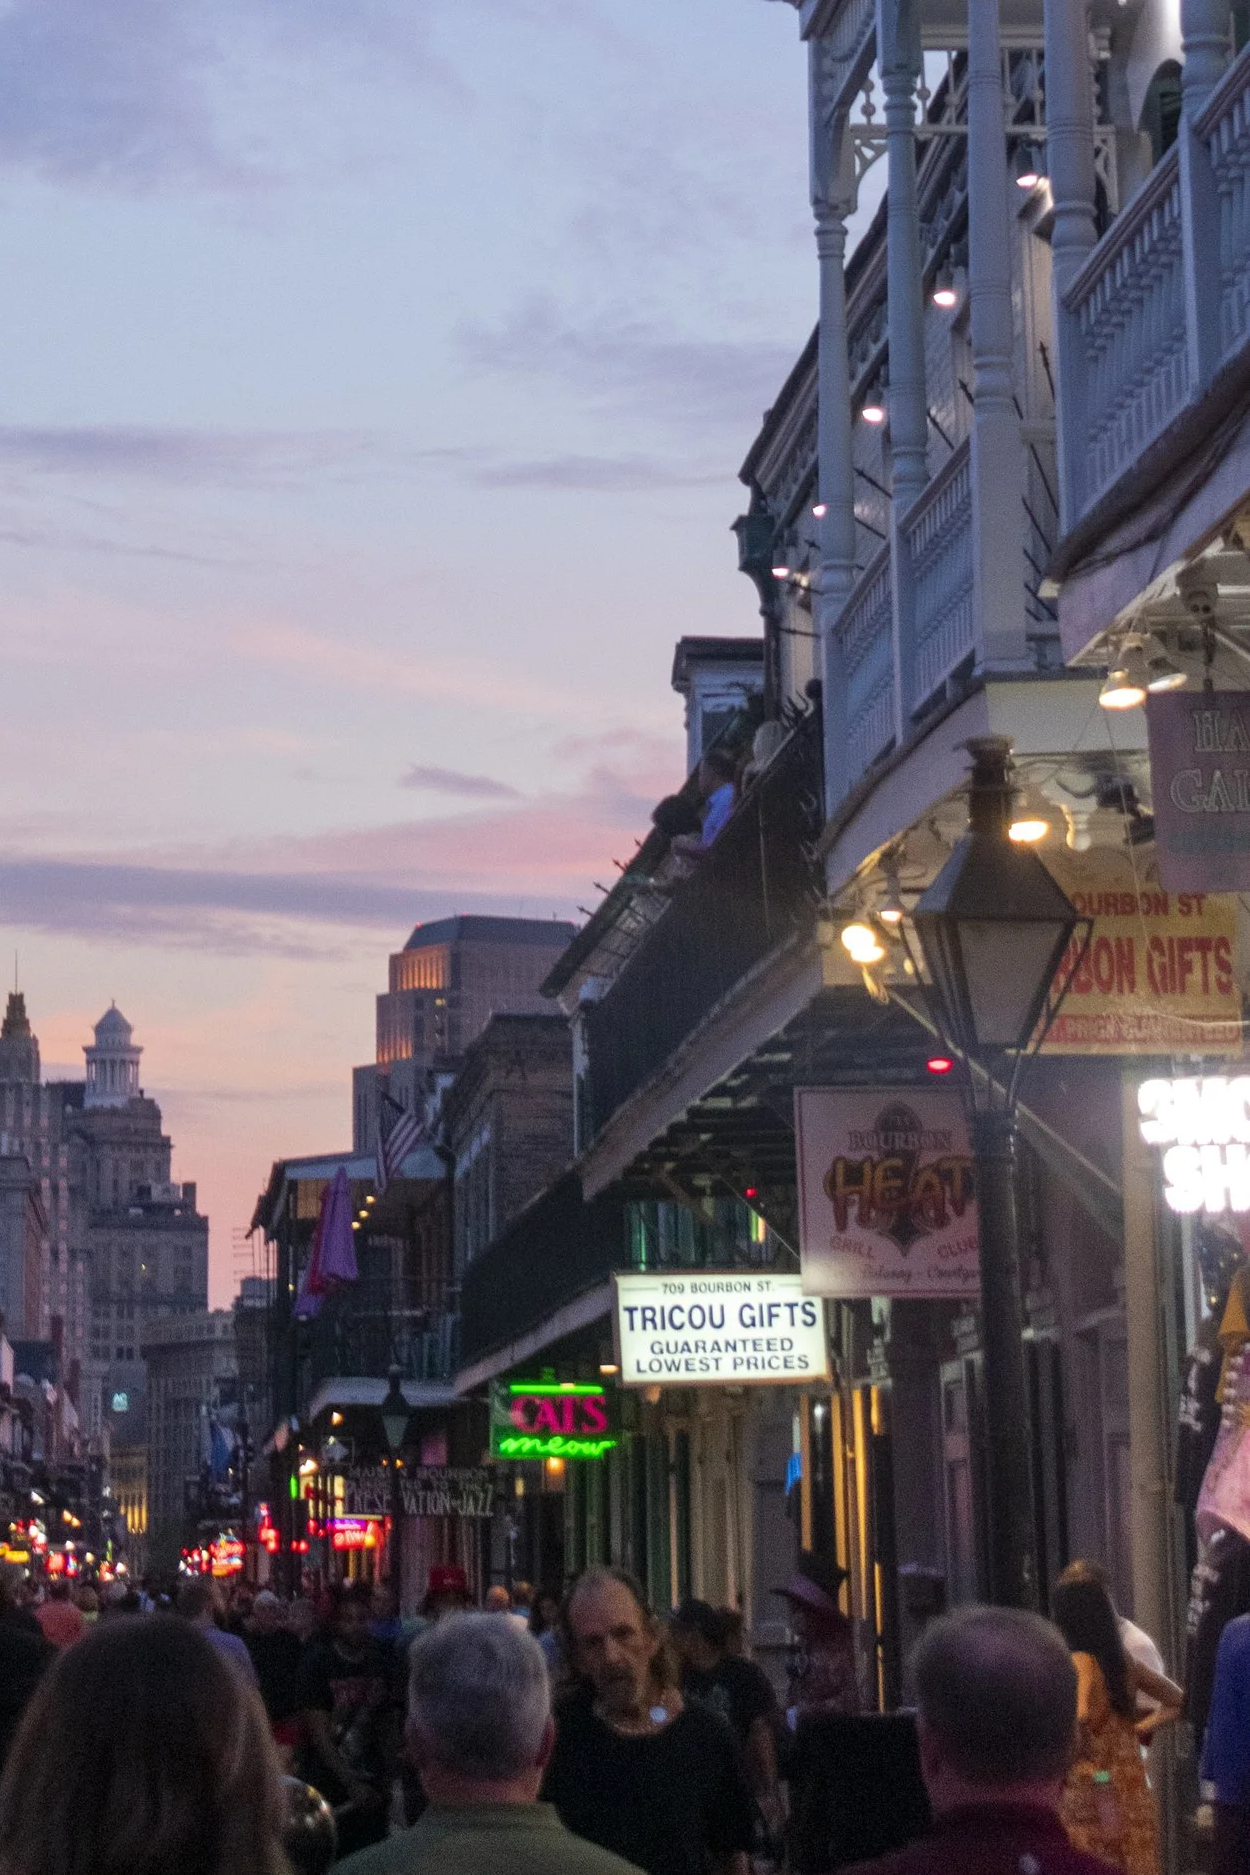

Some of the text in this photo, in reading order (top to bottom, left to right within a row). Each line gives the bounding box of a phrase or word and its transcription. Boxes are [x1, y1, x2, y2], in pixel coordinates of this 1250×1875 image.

[1192, 708, 1250, 752] HA
[1071, 891, 1206, 916] OURBON ST
[1146, 935, 1233, 995] GIFTS
[849, 1130, 952, 1151] BOURBON
[827, 1155, 976, 1233] HEAT
[662, 1280, 775, 1294] 709 BOURBON ST.
[623, 1301, 817, 1331] TRICOU GIFTS
[650, 1338, 794, 1355] GUARANTEED
[636, 1354, 810, 1374] LOWEST PRICES
[511, 1395, 607, 1434] CATS
[499, 1436, 616, 1456] meow
[345, 1482, 494, 1516] PRESEVATION JAZZ
